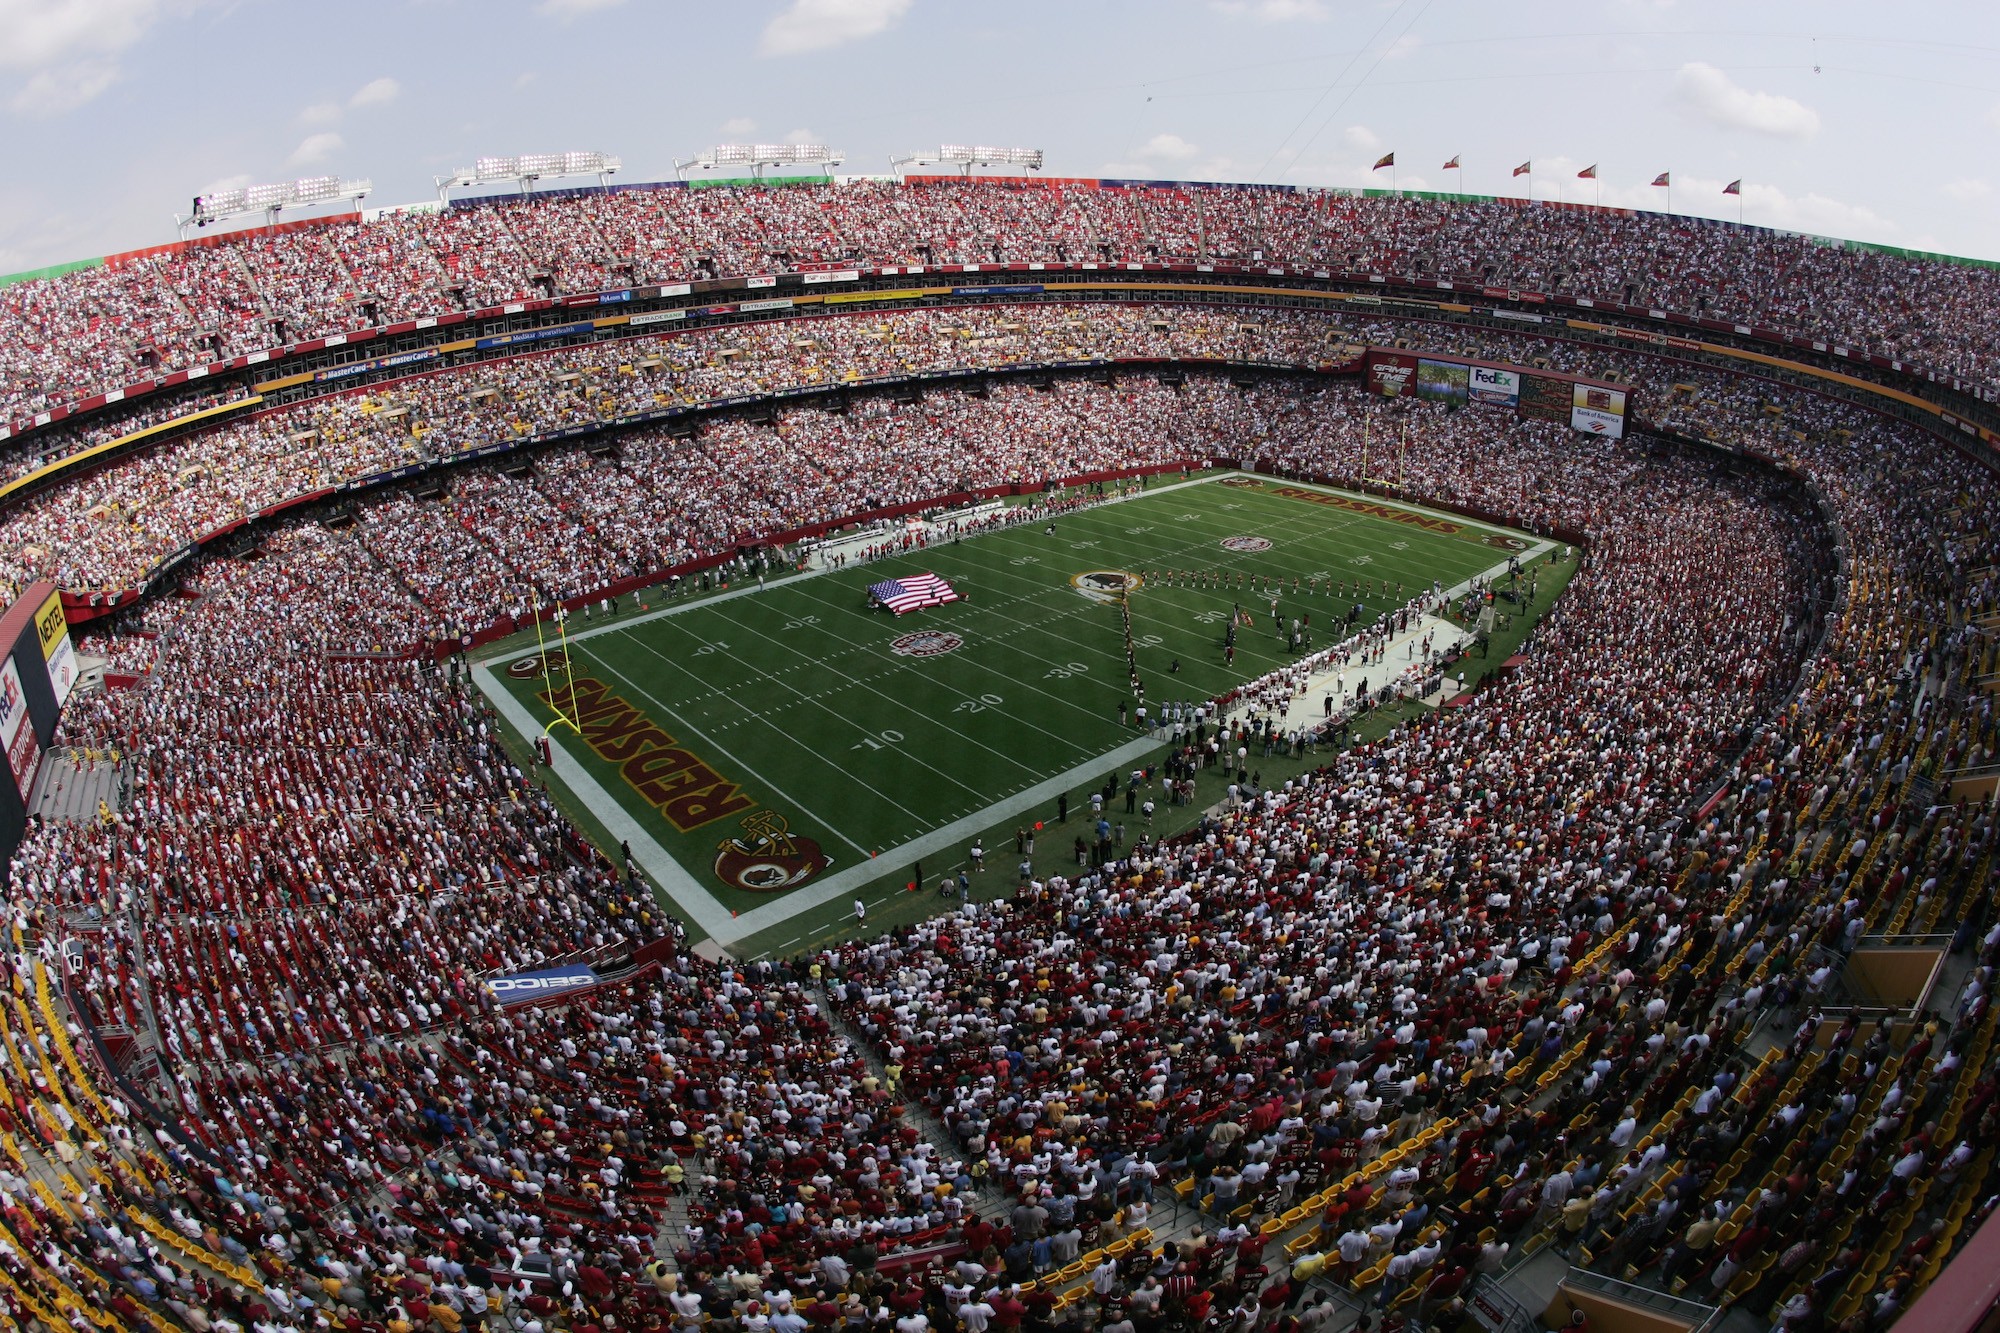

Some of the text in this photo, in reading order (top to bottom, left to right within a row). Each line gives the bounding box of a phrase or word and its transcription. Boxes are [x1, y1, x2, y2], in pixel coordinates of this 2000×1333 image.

[1634, 333, 1649, 341] Easy
[1667, 339, 1700, 350] Travel Easy
[390, 351, 429, 366] MasterCard
[327, 363, 367, 379] MasterCard
[1373, 363, 1413, 375] GAME
[1376, 372, 1407, 382] TIME
[1475, 370, 1511, 386] FedEx
[1550, 382, 1567, 393] THE
[1527, 394, 1564, 406] LAND OF
[1577, 409, 1590, 418] Bank
[1597, 413, 1619, 423] America
[441, 456, 458, 465] FedEx
[478, 446, 500, 456] Teamwork
[350, 479, 367, 489] FedEx
[391, 469, 406, 479] Speed
[1269, 487, 1467, 535] REDSKINS
[786, 615, 821, 629] 20
[1203, 609, 1228, 624] 50
[39, 604, 64, 647] NEXTEL
[698, 640, 732, 655] 10
[1131, 634, 1164, 649] 40
[1050, 662, 1089, 679] 30
[961, 693, 1003, 714] 20
[17, 716, 33, 758] TOYOTA
[862, 730, 905, 751] 10
[534, 677, 758, 833] REDSKINS
[488, 975, 595, 991] GEICO
